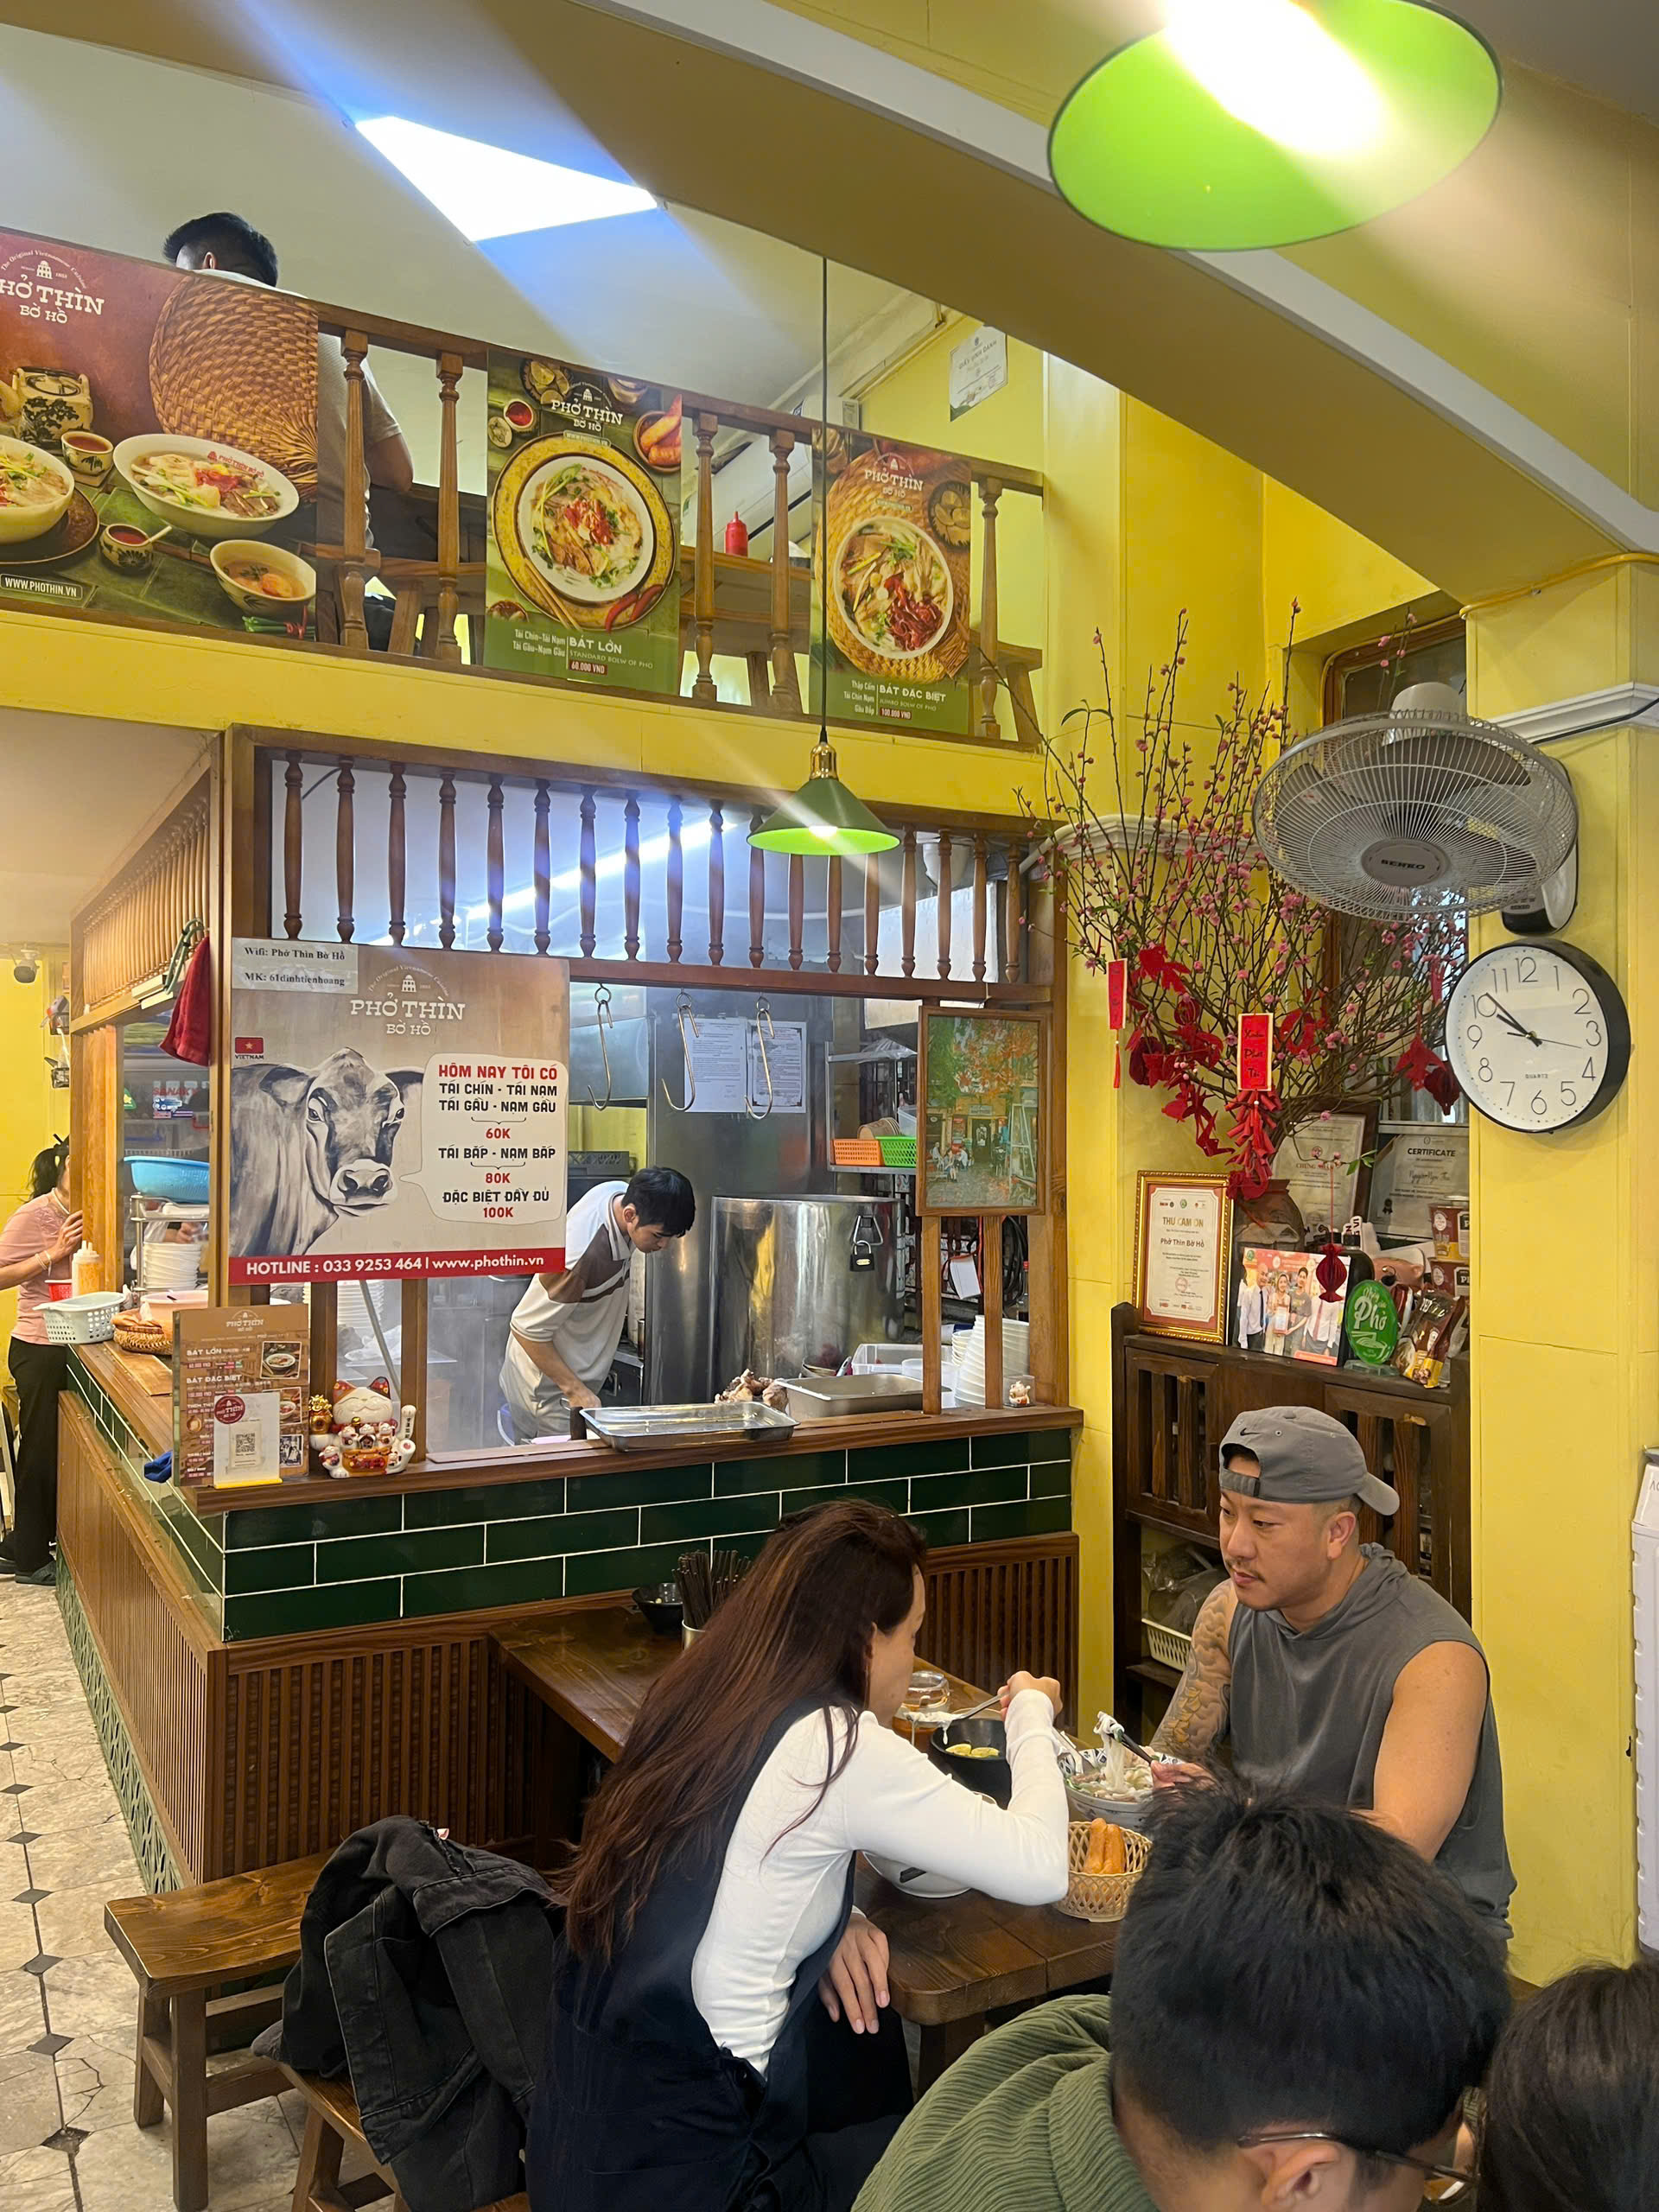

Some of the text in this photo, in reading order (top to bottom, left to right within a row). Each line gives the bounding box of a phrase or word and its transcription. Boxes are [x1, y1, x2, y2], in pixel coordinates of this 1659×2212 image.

[0, 274, 105, 315] HỞ THÌN
[20, 302, 67, 324] BỜ HỒ
[551, 397, 623, 425] PHỞ THÌN
[864, 467, 924, 492] PHỞ THÌN
[5, 577, 77, 597] WWW.PHOTHIN.VN
[569, 635, 594, 650] BÁT
[570, 650, 606, 661] STANDARD
[571, 661, 592, 672] 60.000
[880, 683, 899, 695] BÁT
[244, 947, 269, 957] Wifi:
[271, 948, 290, 958] Phở
[245, 972, 346, 987] MK: 61dinhtienhoang
[1515, 957, 1538, 982] 12
[1553, 965, 1560, 991] 1
[1491, 968, 1509, 994] 11
[350, 992, 466, 1020] PHỞ THÌN
[1471, 993, 1497, 1020] 10
[1573, 988, 1592, 1014] 2
[386, 1019, 431, 1036] BỜ HỒ
[1466, 1024, 1483, 1050] 9
[1586, 1020, 1602, 1047] 3
[438, 1062, 557, 1080] HÔM NAY TÔI CÓ
[1478, 1057, 1493, 1083] 8
[1581, 1056, 1597, 1082] 4
[439, 1079, 460, 1095] TÁI
[464, 1080, 493, 1095] CHÍN
[506, 1081, 526, 1096] TÁI
[531, 1085, 557, 1098] NẠM
[1499, 1081, 1516, 1107] 7
[1560, 1081, 1577, 1107] 5
[439, 1096, 460, 1111] TÁI
[464, 1096, 488, 1112] GẦU
[500, 1101, 528, 1115] NẠM
[532, 1098, 556, 1113] GẦU
[1530, 1090, 1548, 1116] 6
[486, 1128, 512, 1140] 60K
[438, 1144, 459, 1159] TÁI
[463, 1145, 488, 1159] BẮP
[500, 1147, 528, 1161] NẠM
[532, 1145, 556, 1159] BẮP
[1408, 1147, 1456, 1157] CERTIFICATE
[485, 1173, 511, 1184] 80K
[442, 1185, 550, 1205] ĐẶC BIỆT ĐẦY ĐỦ
[483, 1206, 514, 1218] 100K
[246, 1261, 311, 1275] HOTLINE
[322, 1259, 352, 1273] 033
[354, 1258, 391, 1272] 9253
[394, 1257, 423, 1270] 464
[431, 1255, 544, 1270] www.phothin.vn
[1354, 1295, 1387, 1330] Phở
